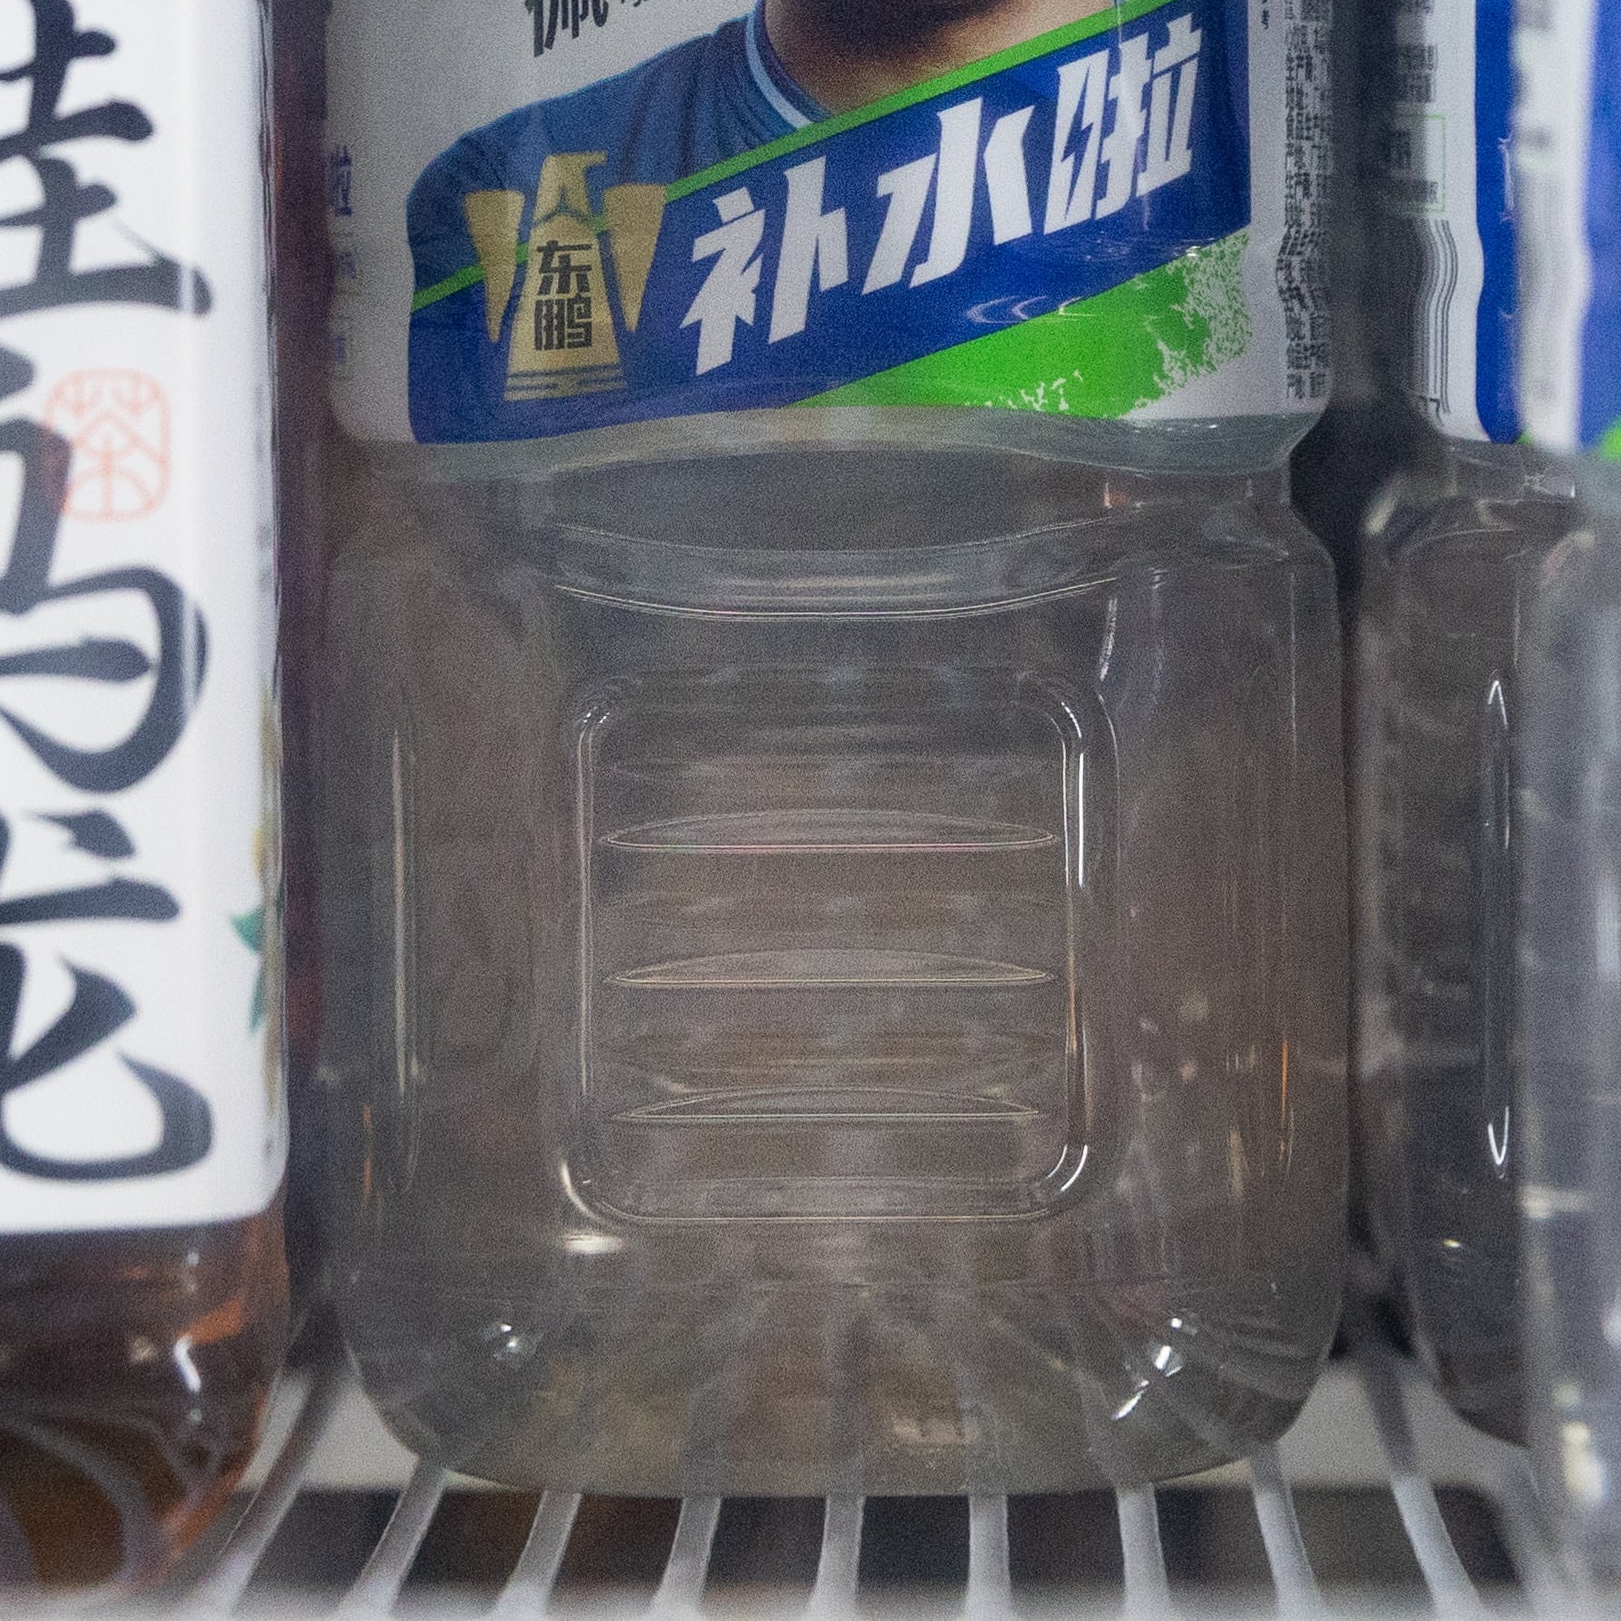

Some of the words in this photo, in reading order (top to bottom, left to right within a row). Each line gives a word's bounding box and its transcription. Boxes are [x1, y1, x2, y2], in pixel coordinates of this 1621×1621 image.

[534, 239, 594, 354] 东鹏
[680, 12, 1204, 376] 补水啦
